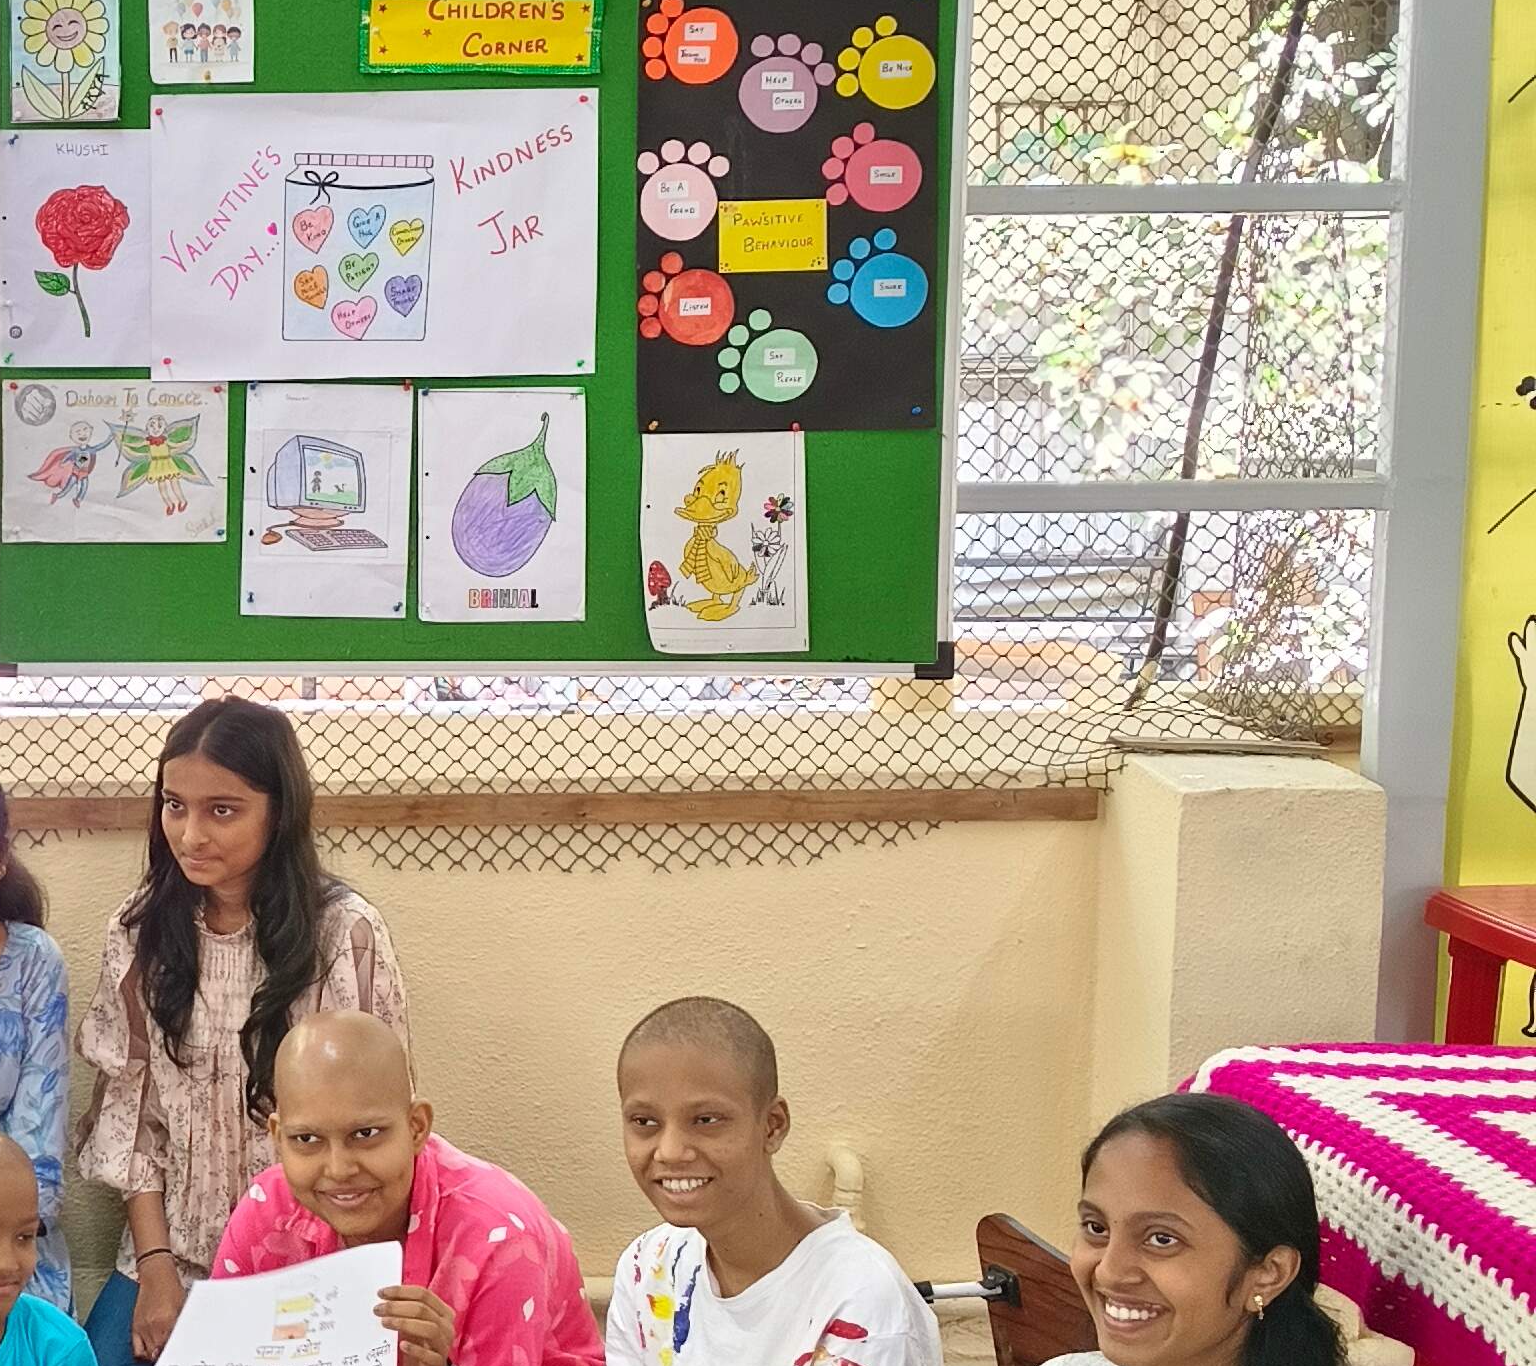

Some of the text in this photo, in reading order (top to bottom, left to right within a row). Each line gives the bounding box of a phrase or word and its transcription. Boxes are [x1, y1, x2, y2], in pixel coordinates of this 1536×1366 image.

[462, 32, 549, 58] CORNER
[55, 143, 110, 156] KHUSHI
[449, 125, 574, 195] KINDNESS
[160, 145, 281, 273] VALENTINE'S
[477, 210, 544, 256] JAR
[743, 237, 813, 253] BEHAVIOUR
[469, 588, 539, 609] BRINJAL
